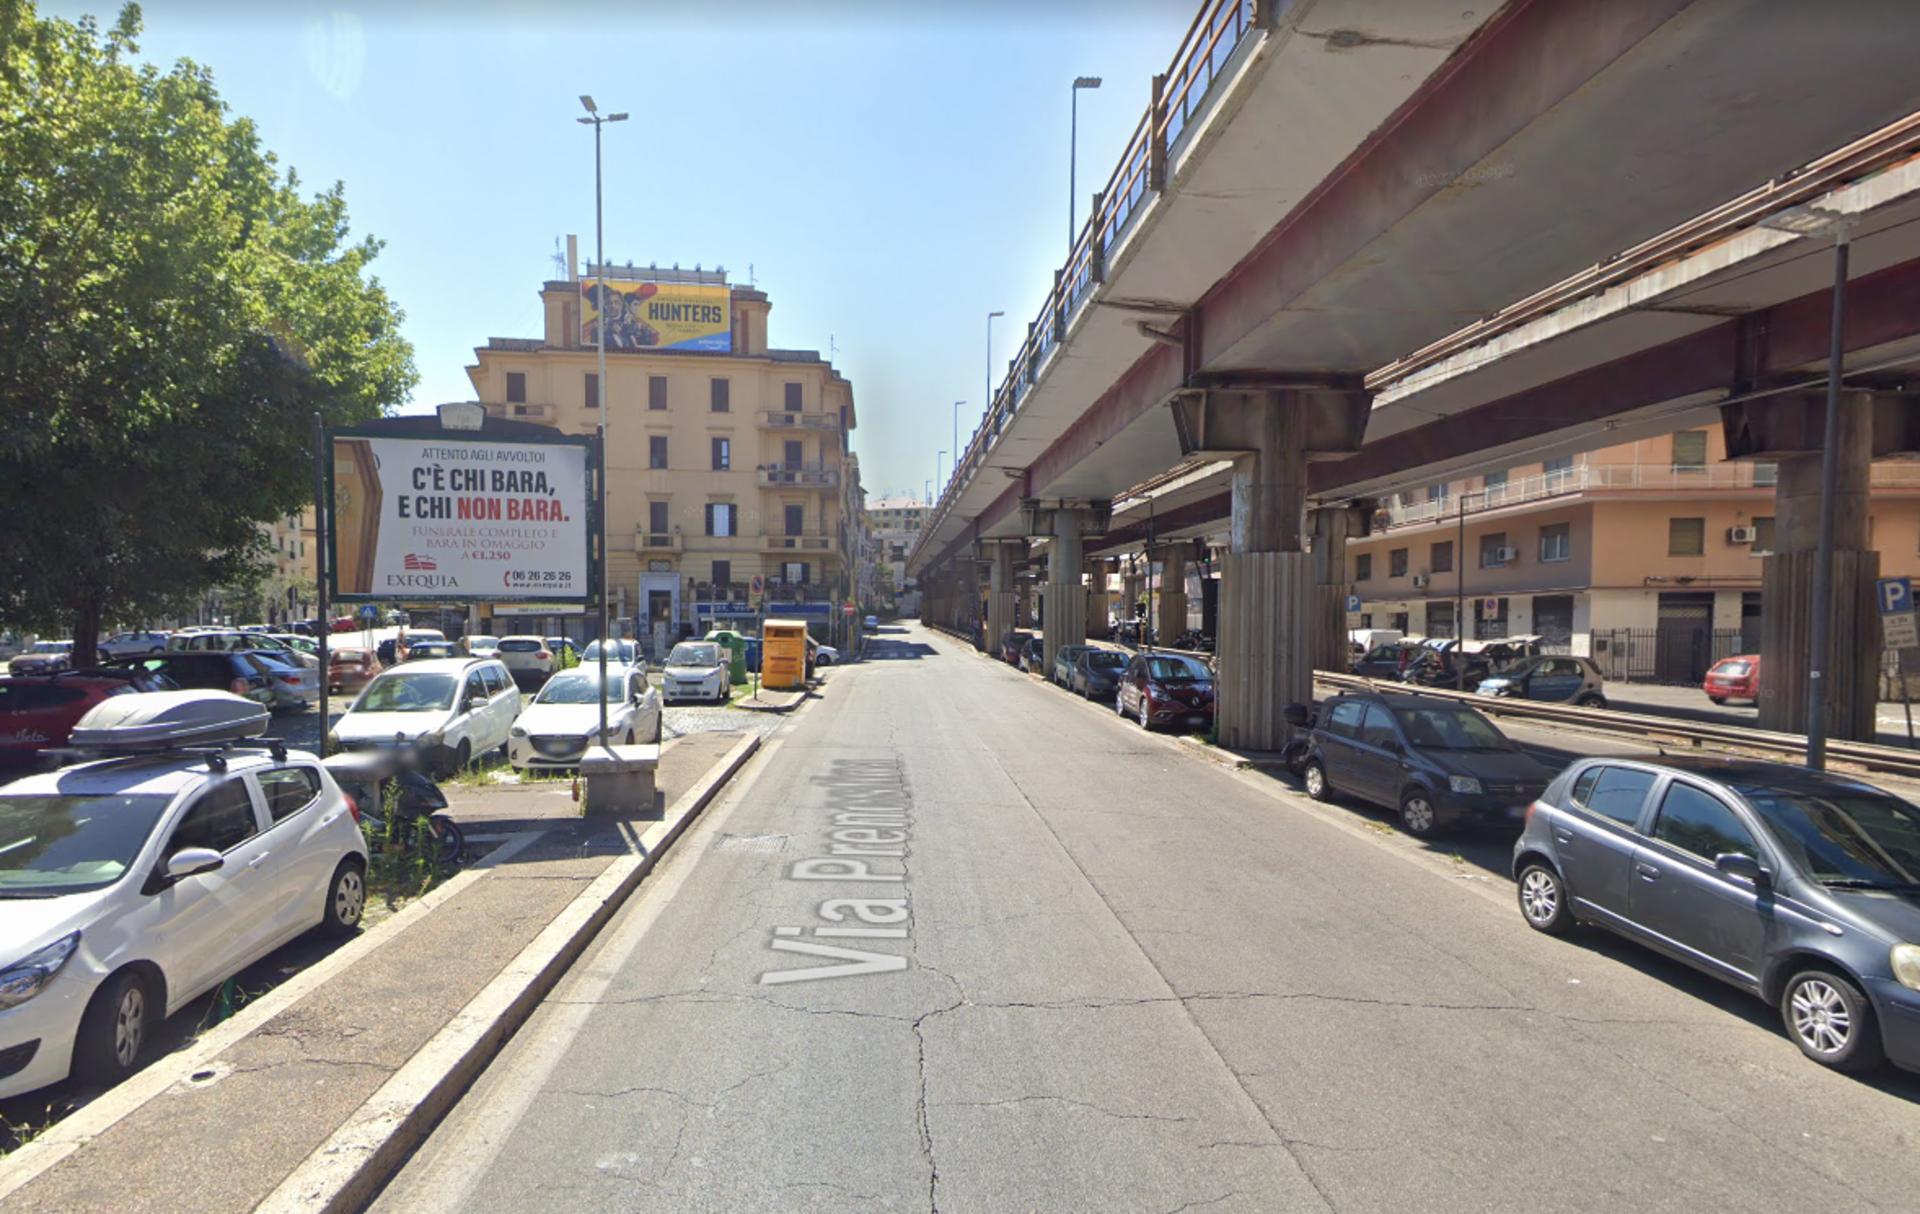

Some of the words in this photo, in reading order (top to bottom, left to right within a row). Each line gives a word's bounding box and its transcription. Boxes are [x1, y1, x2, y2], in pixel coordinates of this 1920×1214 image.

[648, 302, 722, 323] HUNTERS
[422, 448, 468, 461] ATTENTO
[470, 449, 493, 461] AGLI
[497, 450, 545, 463] AVVOLTOI
[412, 464, 445, 491] C'È
[450, 468, 485, 492] CHI
[492, 469, 556, 496] BARA,
[398, 495, 410, 519] E
[415, 496, 451, 519] CHI
[457, 497, 501, 521] NON
[507, 498, 570, 522] BARA.
[412, 526, 475, 538] FUNERALE
[478, 527, 548, 538] COMPLETO
[552, 529, 558, 538] E
[426, 538, 459, 549] BARA
[462, 539, 477, 549] IN
[481, 538, 546, 550] OMAGGIO
[461, 551, 469, 560] A
[387, 575, 460, 589] EXEQUIA
[512, 571, 526, 581] 06
[527, 571, 541, 581] 26
[558, 571, 572, 581] 26
[1349, 596, 1358, 610] P
[1885, 582, 1905, 610] P
